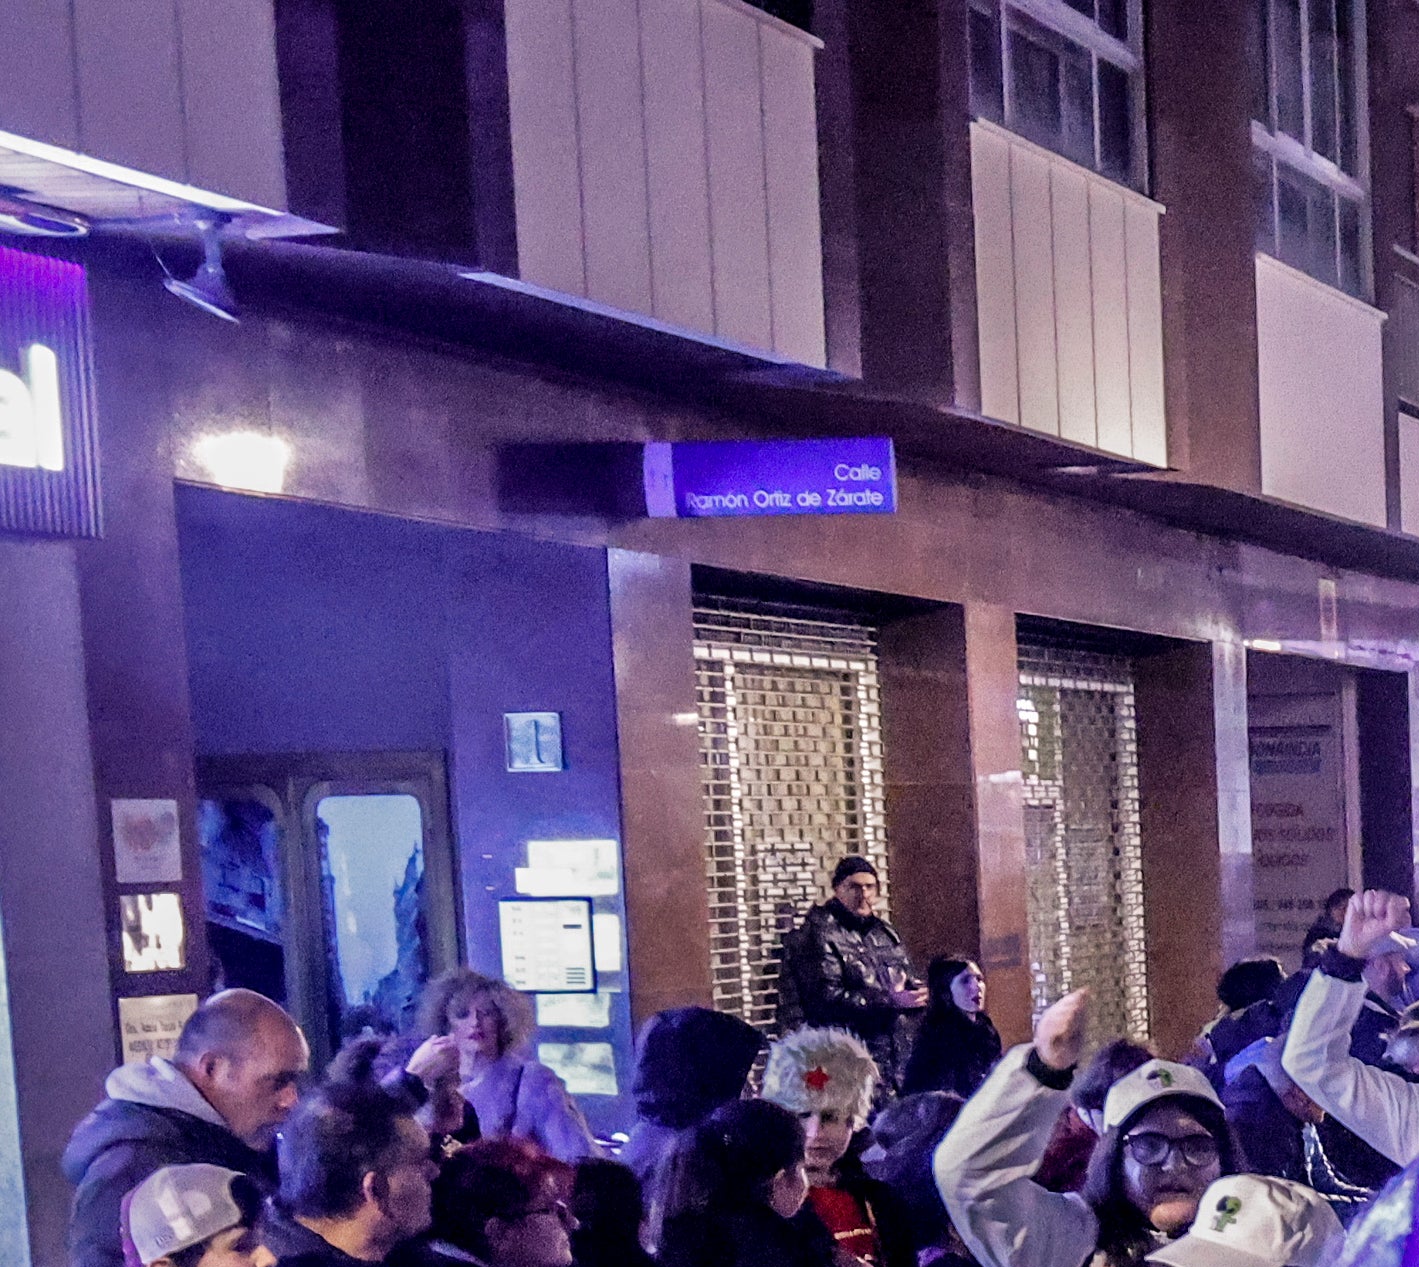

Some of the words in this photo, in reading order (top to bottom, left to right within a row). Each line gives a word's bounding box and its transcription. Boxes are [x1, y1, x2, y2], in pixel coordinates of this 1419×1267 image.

[834, 463, 882, 482] Calle
[753, 489, 792, 508] Ortiz
[797, 490, 822, 506] de
[826, 487, 884, 507] Zárate
